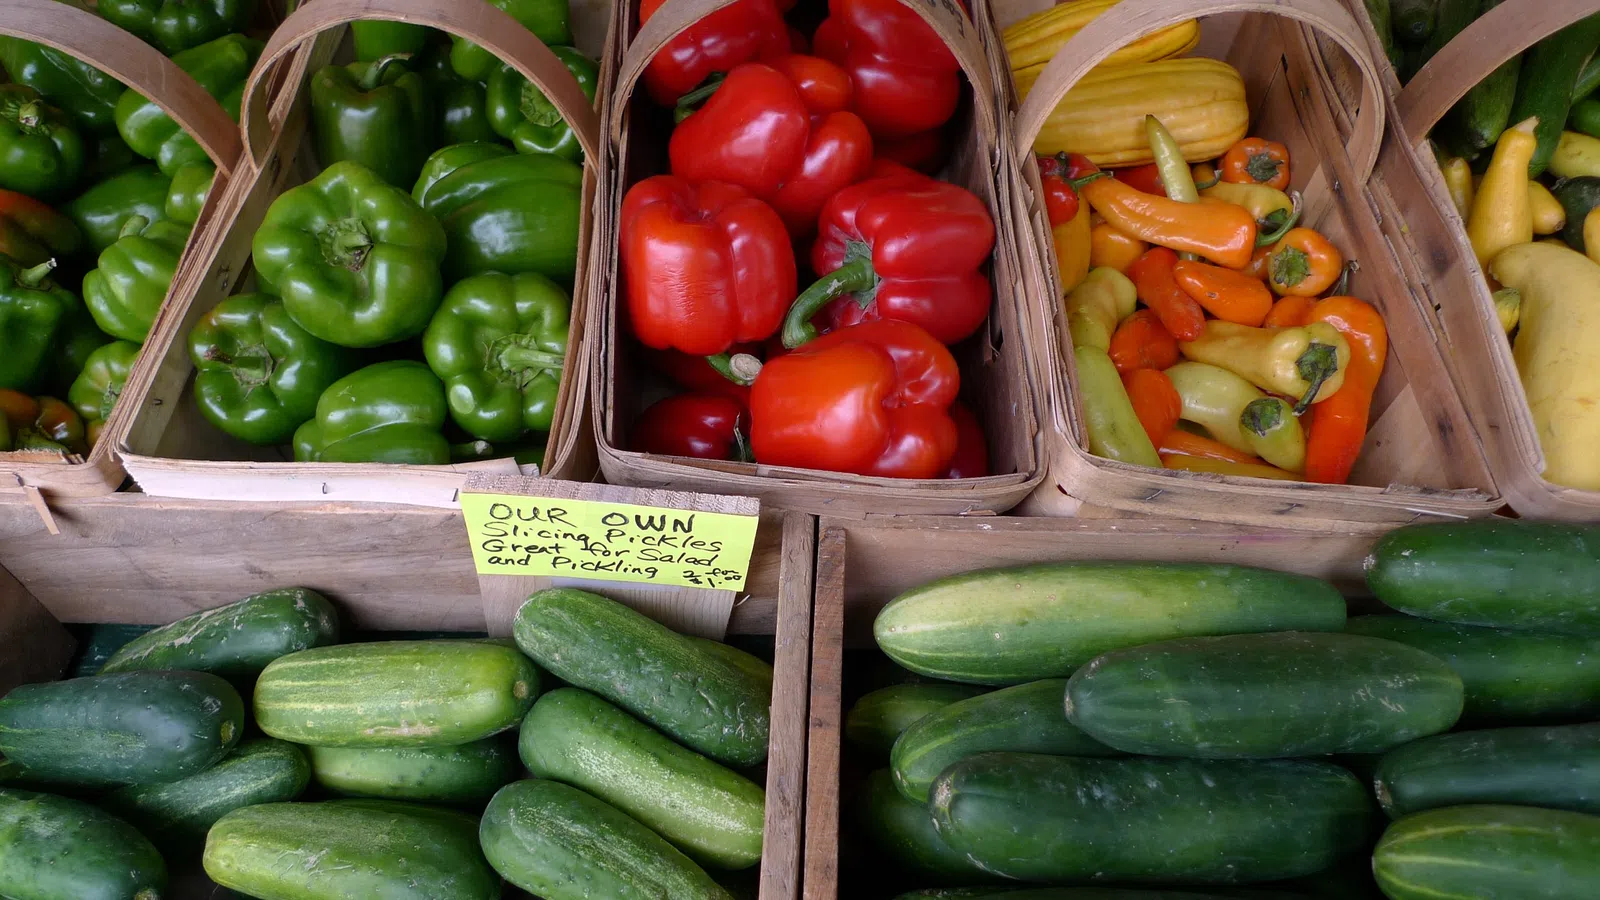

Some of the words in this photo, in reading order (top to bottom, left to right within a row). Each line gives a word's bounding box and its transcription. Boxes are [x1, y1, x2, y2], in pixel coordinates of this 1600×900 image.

[490, 503, 578, 528] OUR
[601, 512, 696, 533] OWN
[482, 521, 591, 551] Slicing
[605, 529, 723, 552] Pickles
[482, 539, 568, 554] Great
[589, 542, 630, 557] for
[637, 548, 719, 567] Salad
[487, 554, 532, 566] and
[551, 556, 659, 579] Pickling
